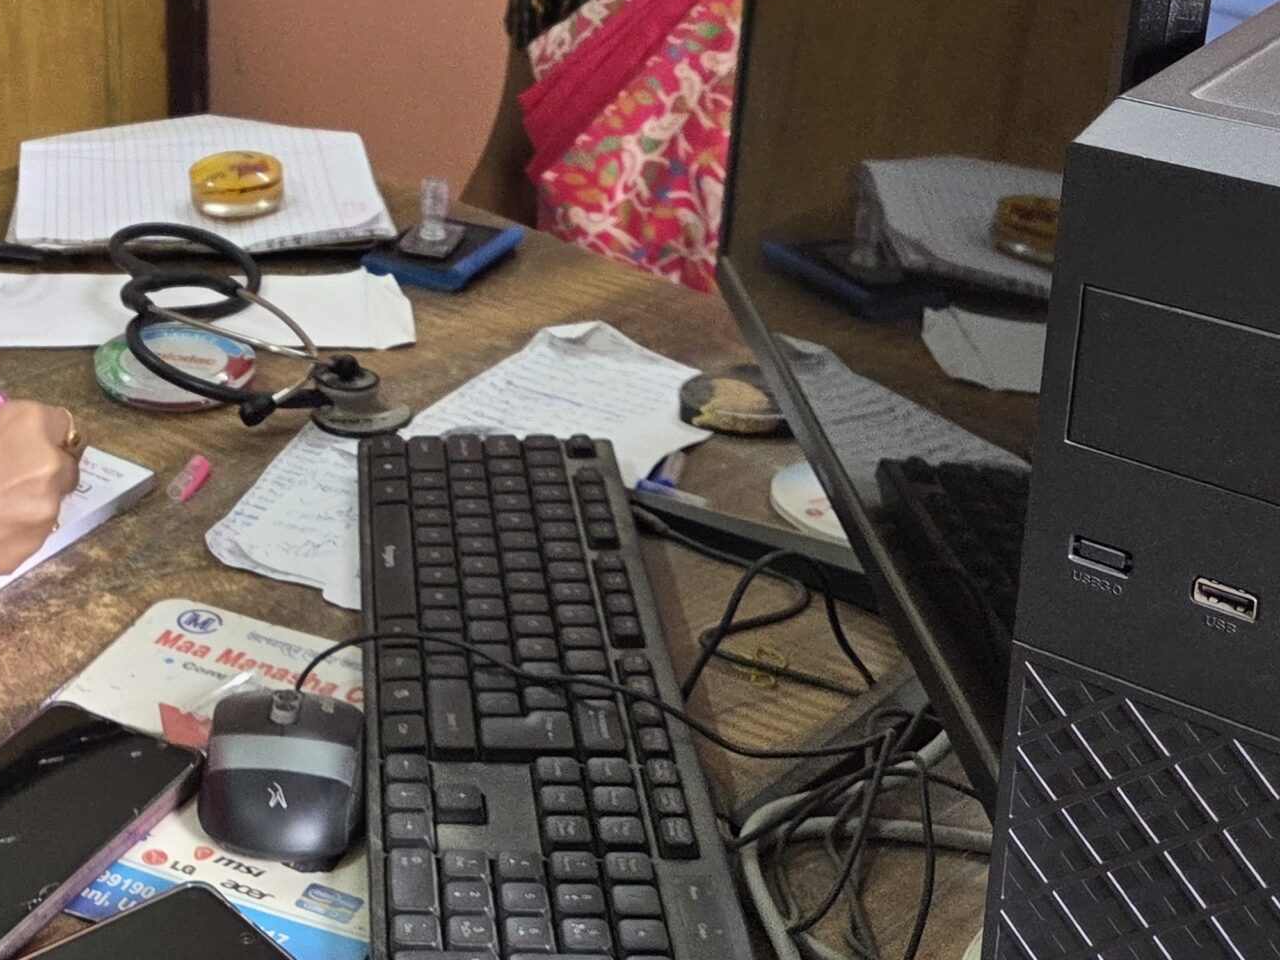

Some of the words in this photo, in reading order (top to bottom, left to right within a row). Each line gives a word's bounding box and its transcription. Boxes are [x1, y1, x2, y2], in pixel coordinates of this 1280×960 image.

[1205, 615, 1238, 635] USB
[155, 629, 212, 659] Maa
[215, 647, 339, 696] Manasha
[170, 860, 196, 876] LG
[213, 855, 267, 877] msi
[220, 878, 276, 901] acer
